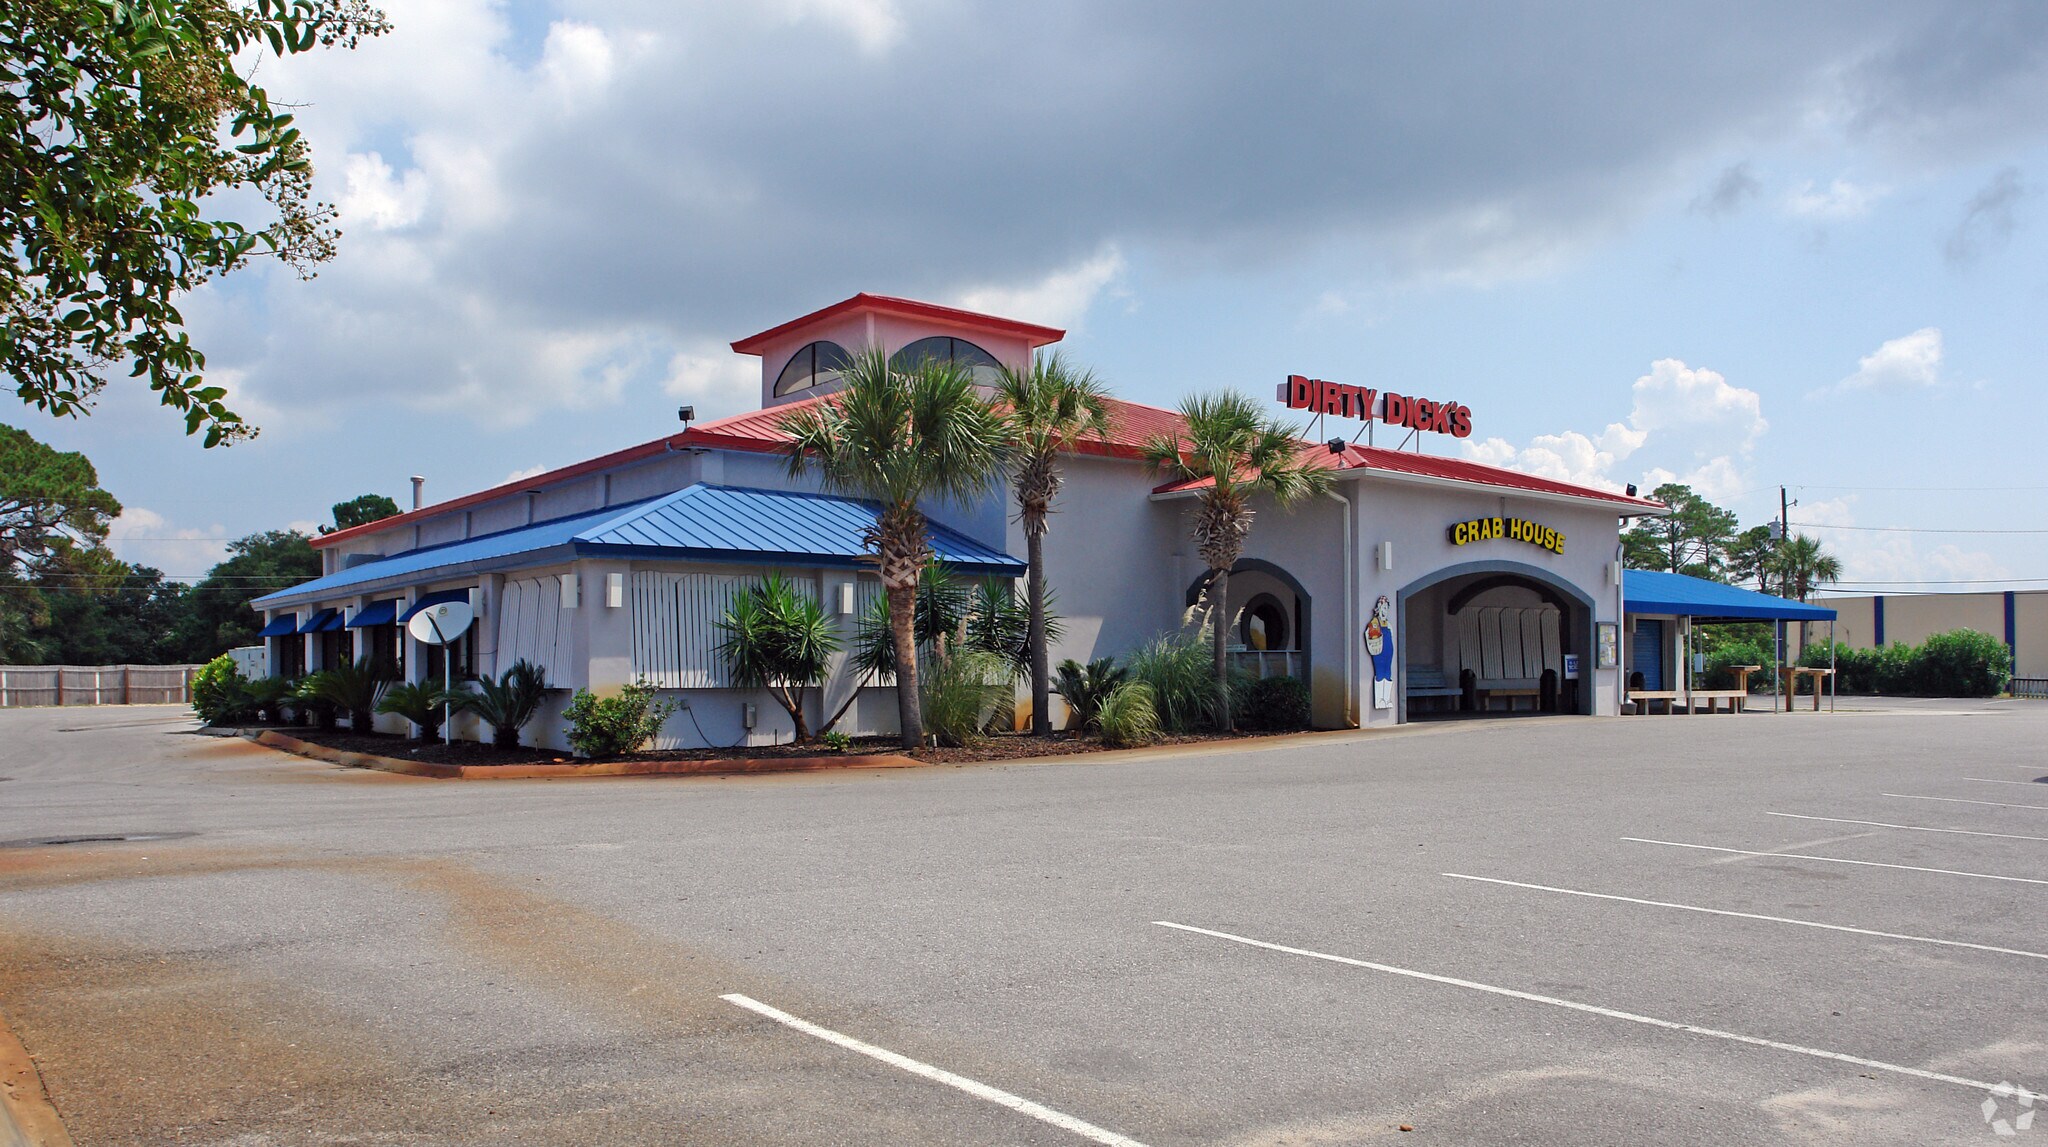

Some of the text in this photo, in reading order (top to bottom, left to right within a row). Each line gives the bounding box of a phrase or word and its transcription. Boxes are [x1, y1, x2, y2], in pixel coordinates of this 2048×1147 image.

[1287, 375, 1472, 438] DIRTY DICK'S
[1450, 517, 1566, 555] CRAB HOUSE
